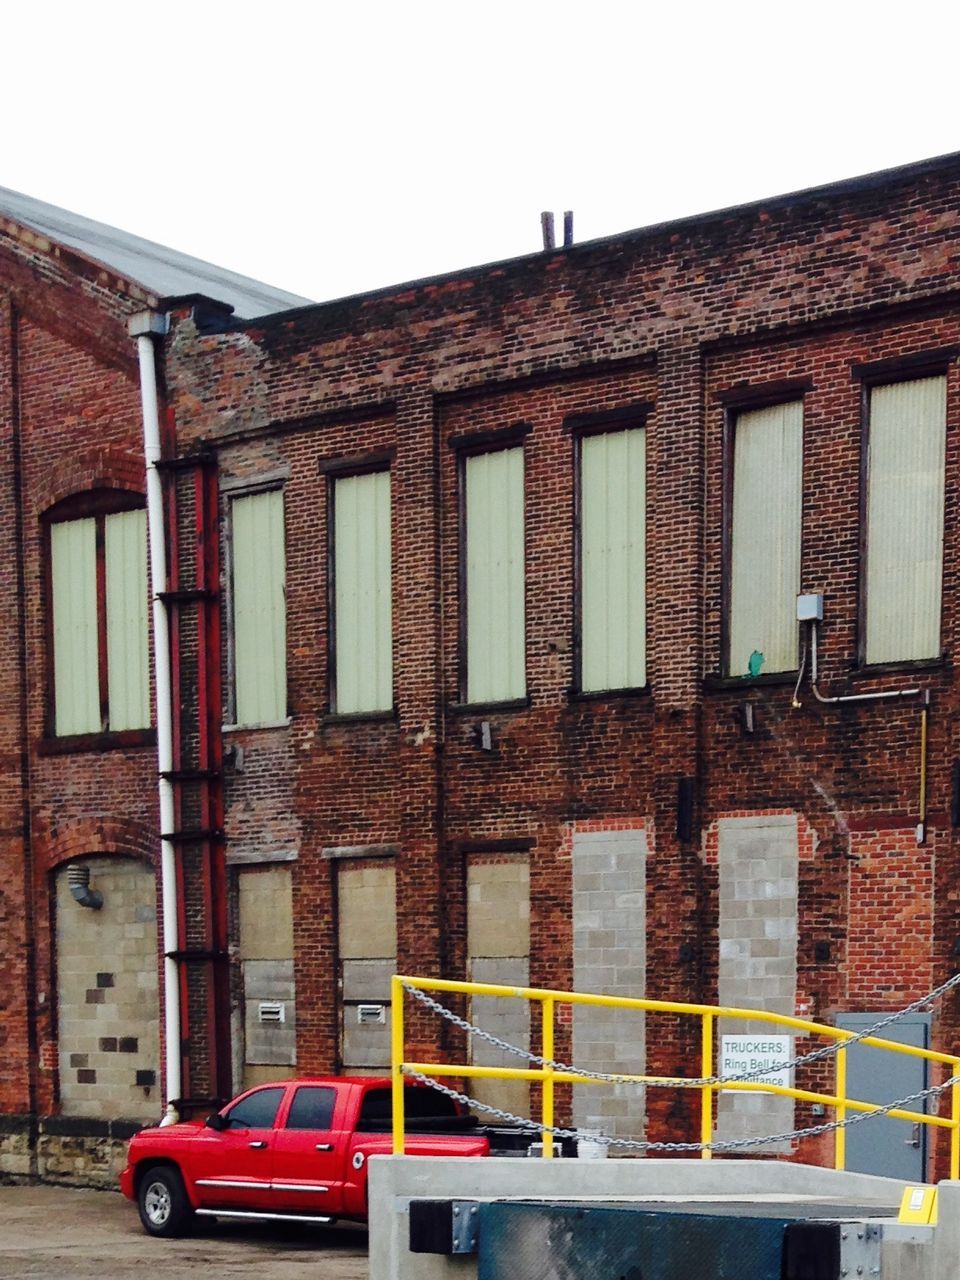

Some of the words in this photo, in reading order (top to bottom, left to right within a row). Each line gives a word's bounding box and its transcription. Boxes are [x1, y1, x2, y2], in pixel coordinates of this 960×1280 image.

[725, 1058, 747, 1072] Ring
[750, 1058, 770, 1069] Bell
[772, 1058, 784, 1068] fo
